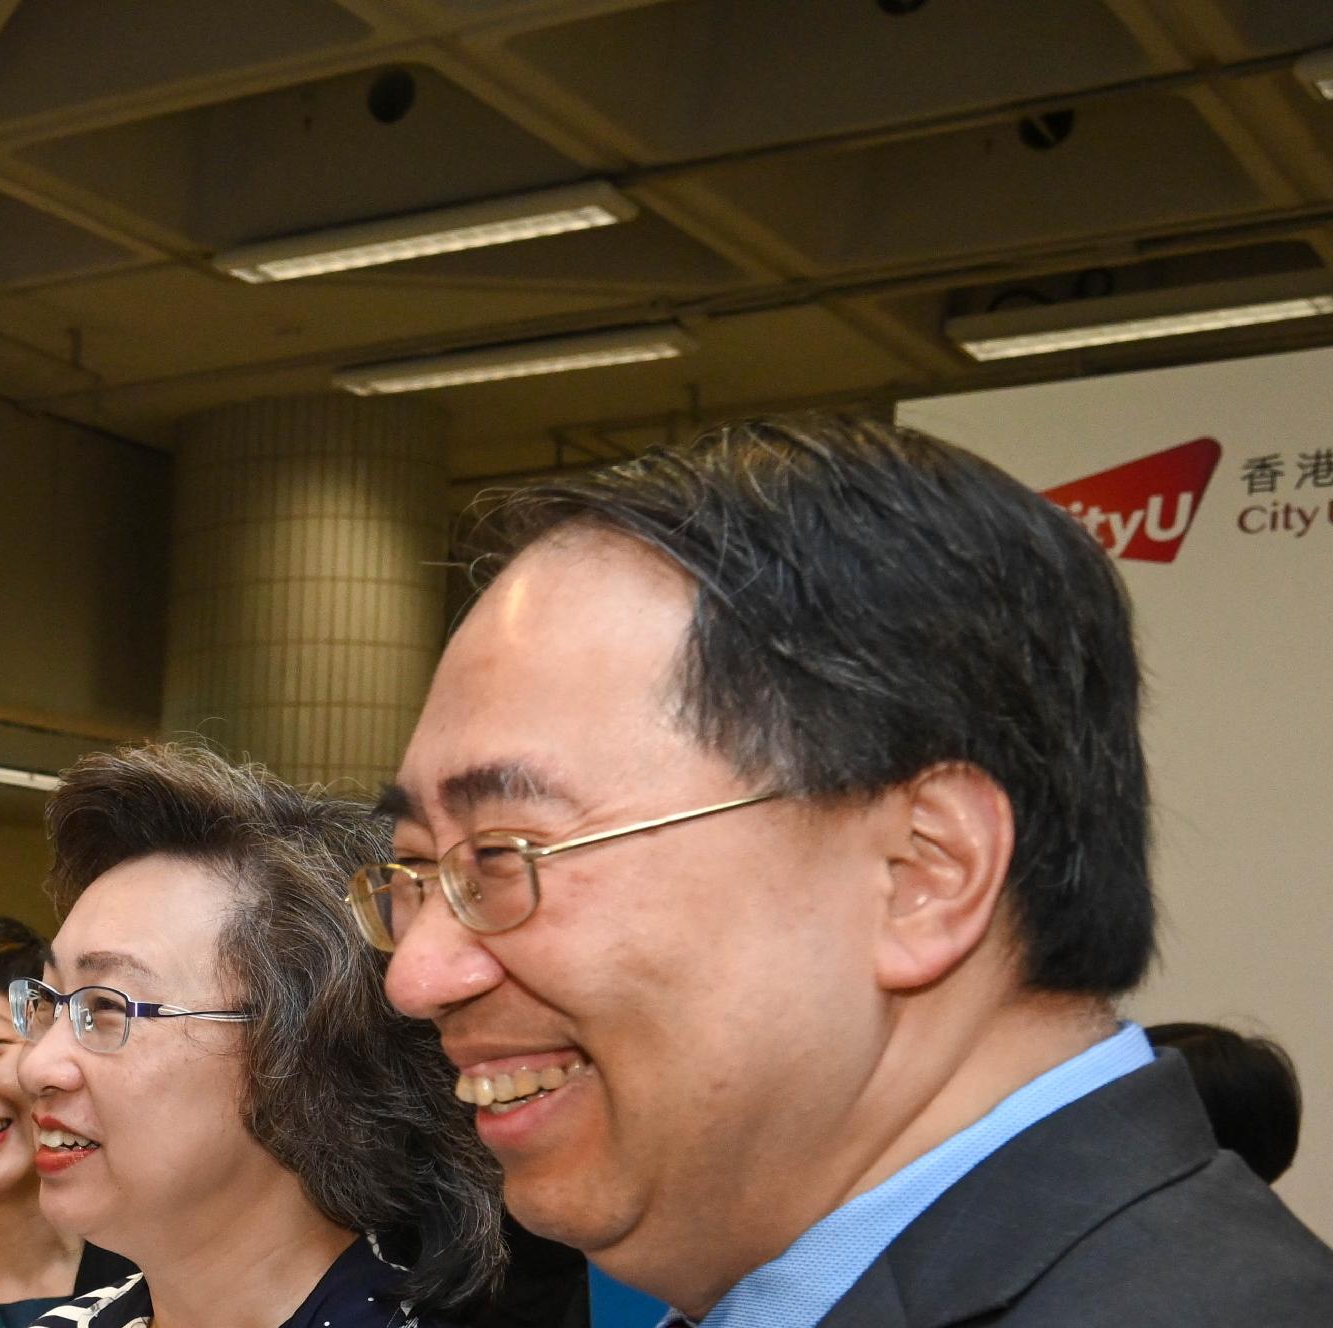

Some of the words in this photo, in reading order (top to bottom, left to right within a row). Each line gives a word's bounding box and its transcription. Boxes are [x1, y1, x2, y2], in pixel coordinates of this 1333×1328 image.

[1241, 450, 1333, 495] 香港
[1054, 491, 1193, 557] tyU
[1237, 501, 1320, 539] City
